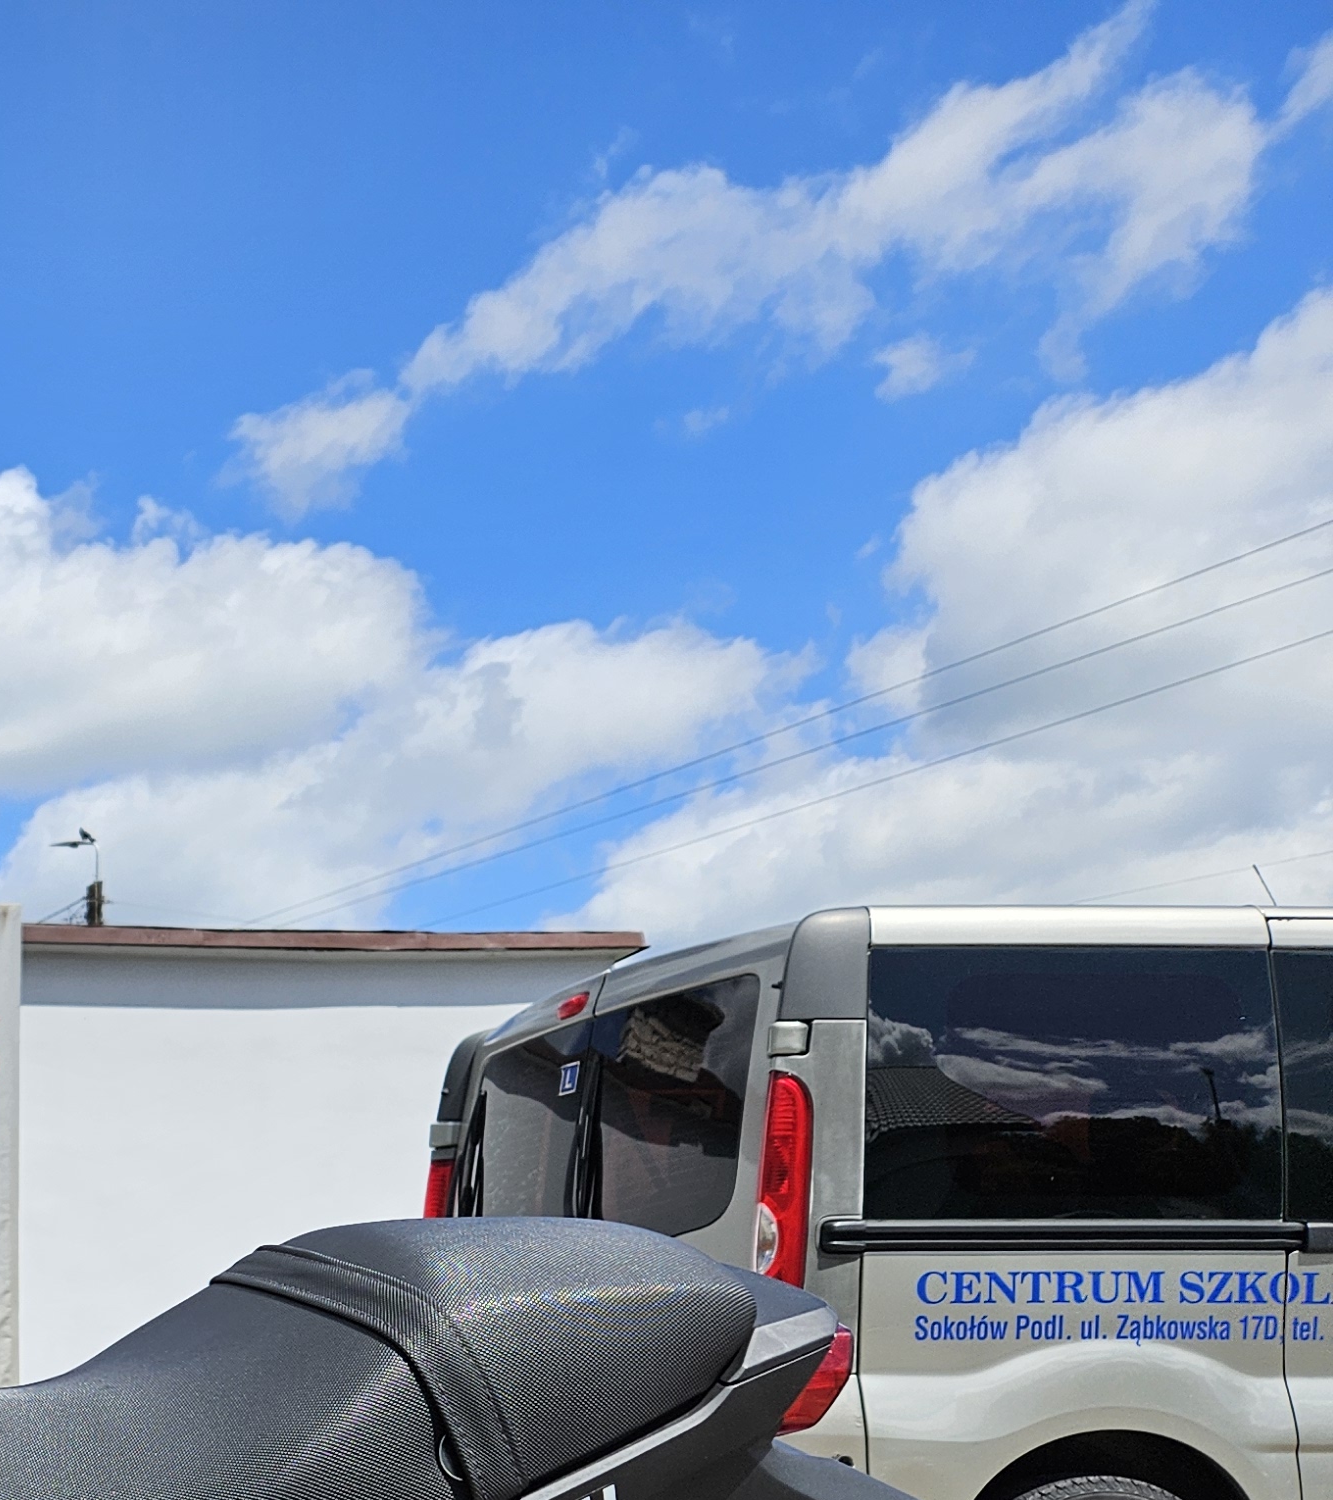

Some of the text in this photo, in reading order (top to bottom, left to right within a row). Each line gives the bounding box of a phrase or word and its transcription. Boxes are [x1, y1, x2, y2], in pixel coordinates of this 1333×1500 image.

[915, 1270, 1333, 1305] CENTRUM SZKOL
[914, 1314, 1324, 1347] Sokołów Podl. ul. Ząbkowska 17D, tel.
